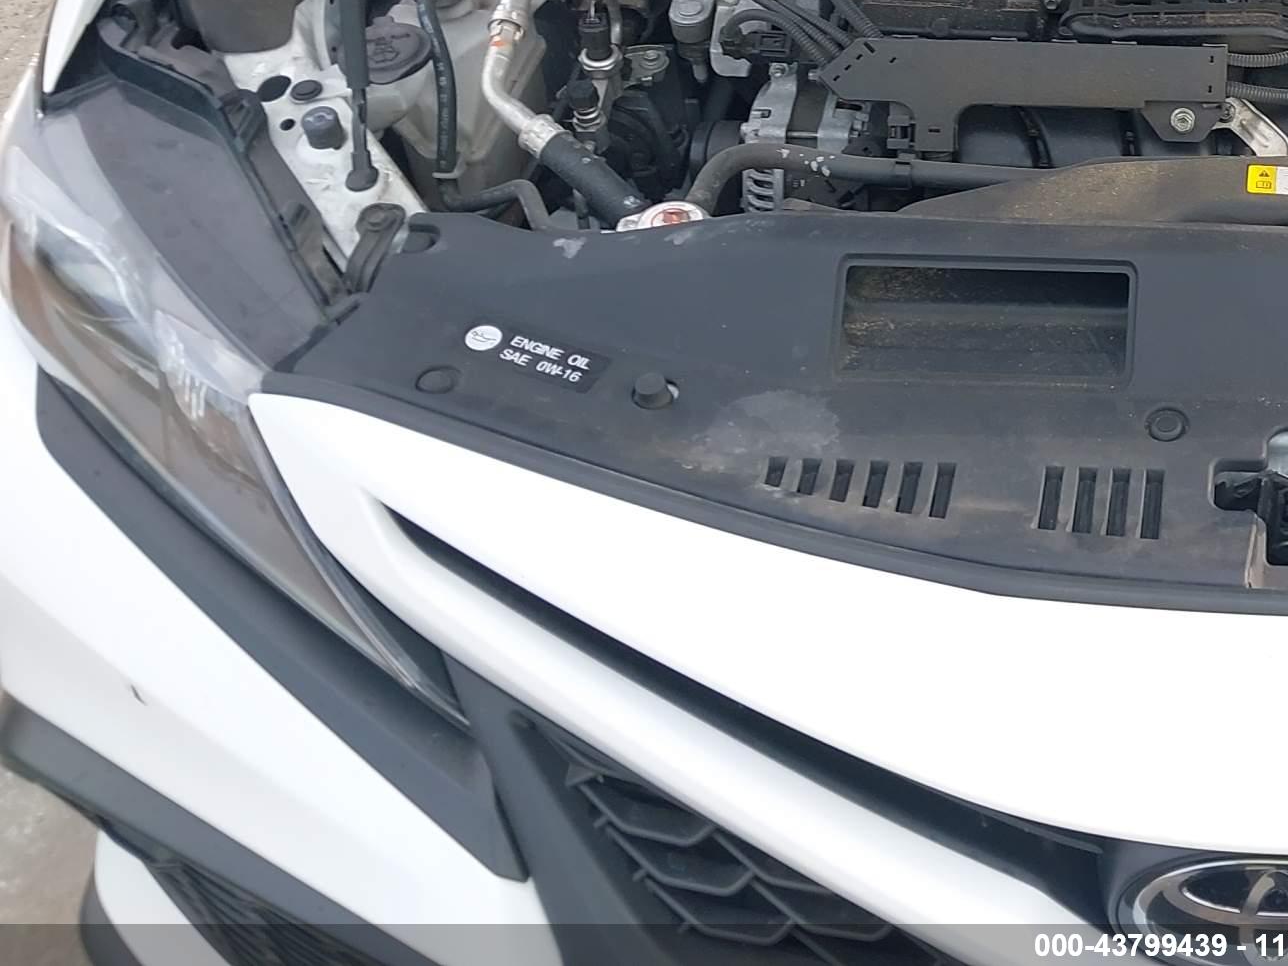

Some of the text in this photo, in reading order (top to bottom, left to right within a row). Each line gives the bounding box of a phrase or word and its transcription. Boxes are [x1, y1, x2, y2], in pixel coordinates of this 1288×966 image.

[499, 348, 583, 383] SAE 0W-16
[510, 335, 591, 371] ENGINE OIL
